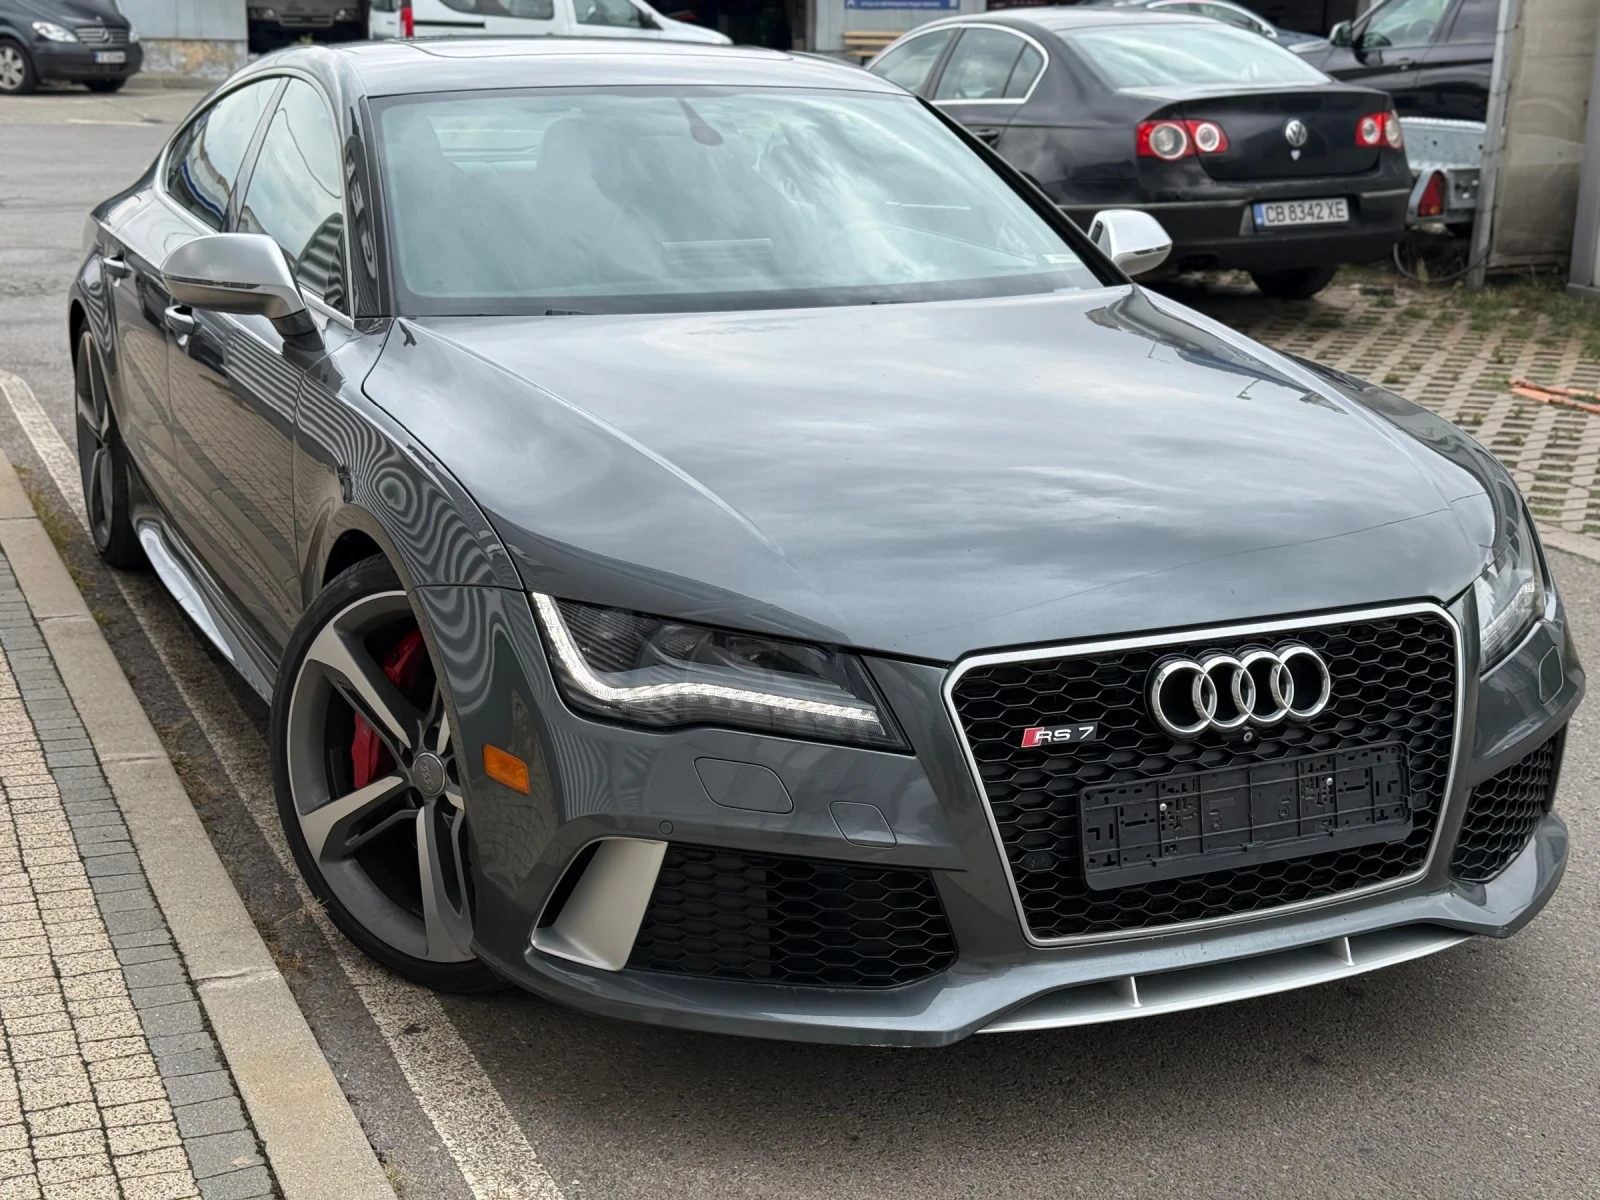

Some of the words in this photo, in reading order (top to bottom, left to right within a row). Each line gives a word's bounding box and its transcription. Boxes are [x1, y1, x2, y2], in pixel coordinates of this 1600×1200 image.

[1265, 205, 1285, 222] CB
[1288, 202, 1324, 221] 8342
[1326, 201, 1345, 219] XE
[1033, 729, 1071, 743] RS
[1079, 726, 1094, 739] 7
